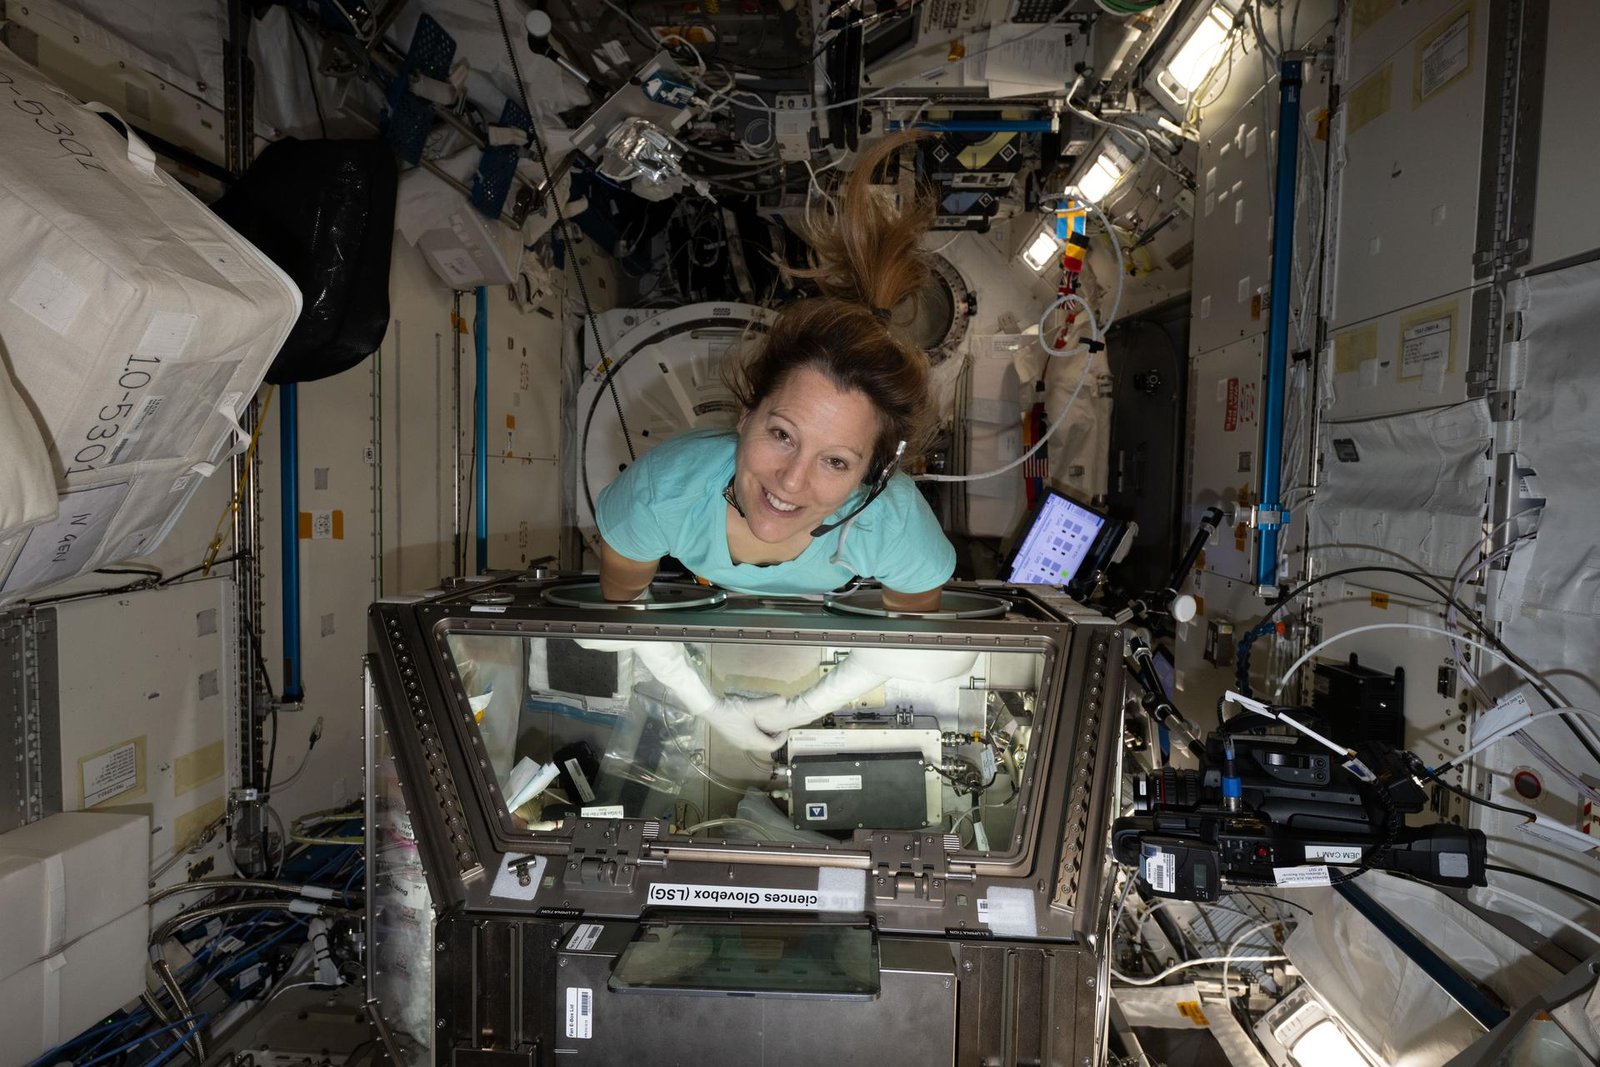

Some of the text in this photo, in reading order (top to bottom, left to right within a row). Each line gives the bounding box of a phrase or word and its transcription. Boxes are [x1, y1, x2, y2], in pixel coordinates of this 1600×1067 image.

[64, 354, 162, 480] 1.0-5301
[1322, 851, 1341, 860] CAM
[1343, 852, 1360, 860] JEM
[650, 885, 690, 902] (LSG)
[693, 889, 760, 905] Glovebox
[540, 908, 580, 916] ILLUMINATION
[949, 929, 990, 937] ILLUMINATION
